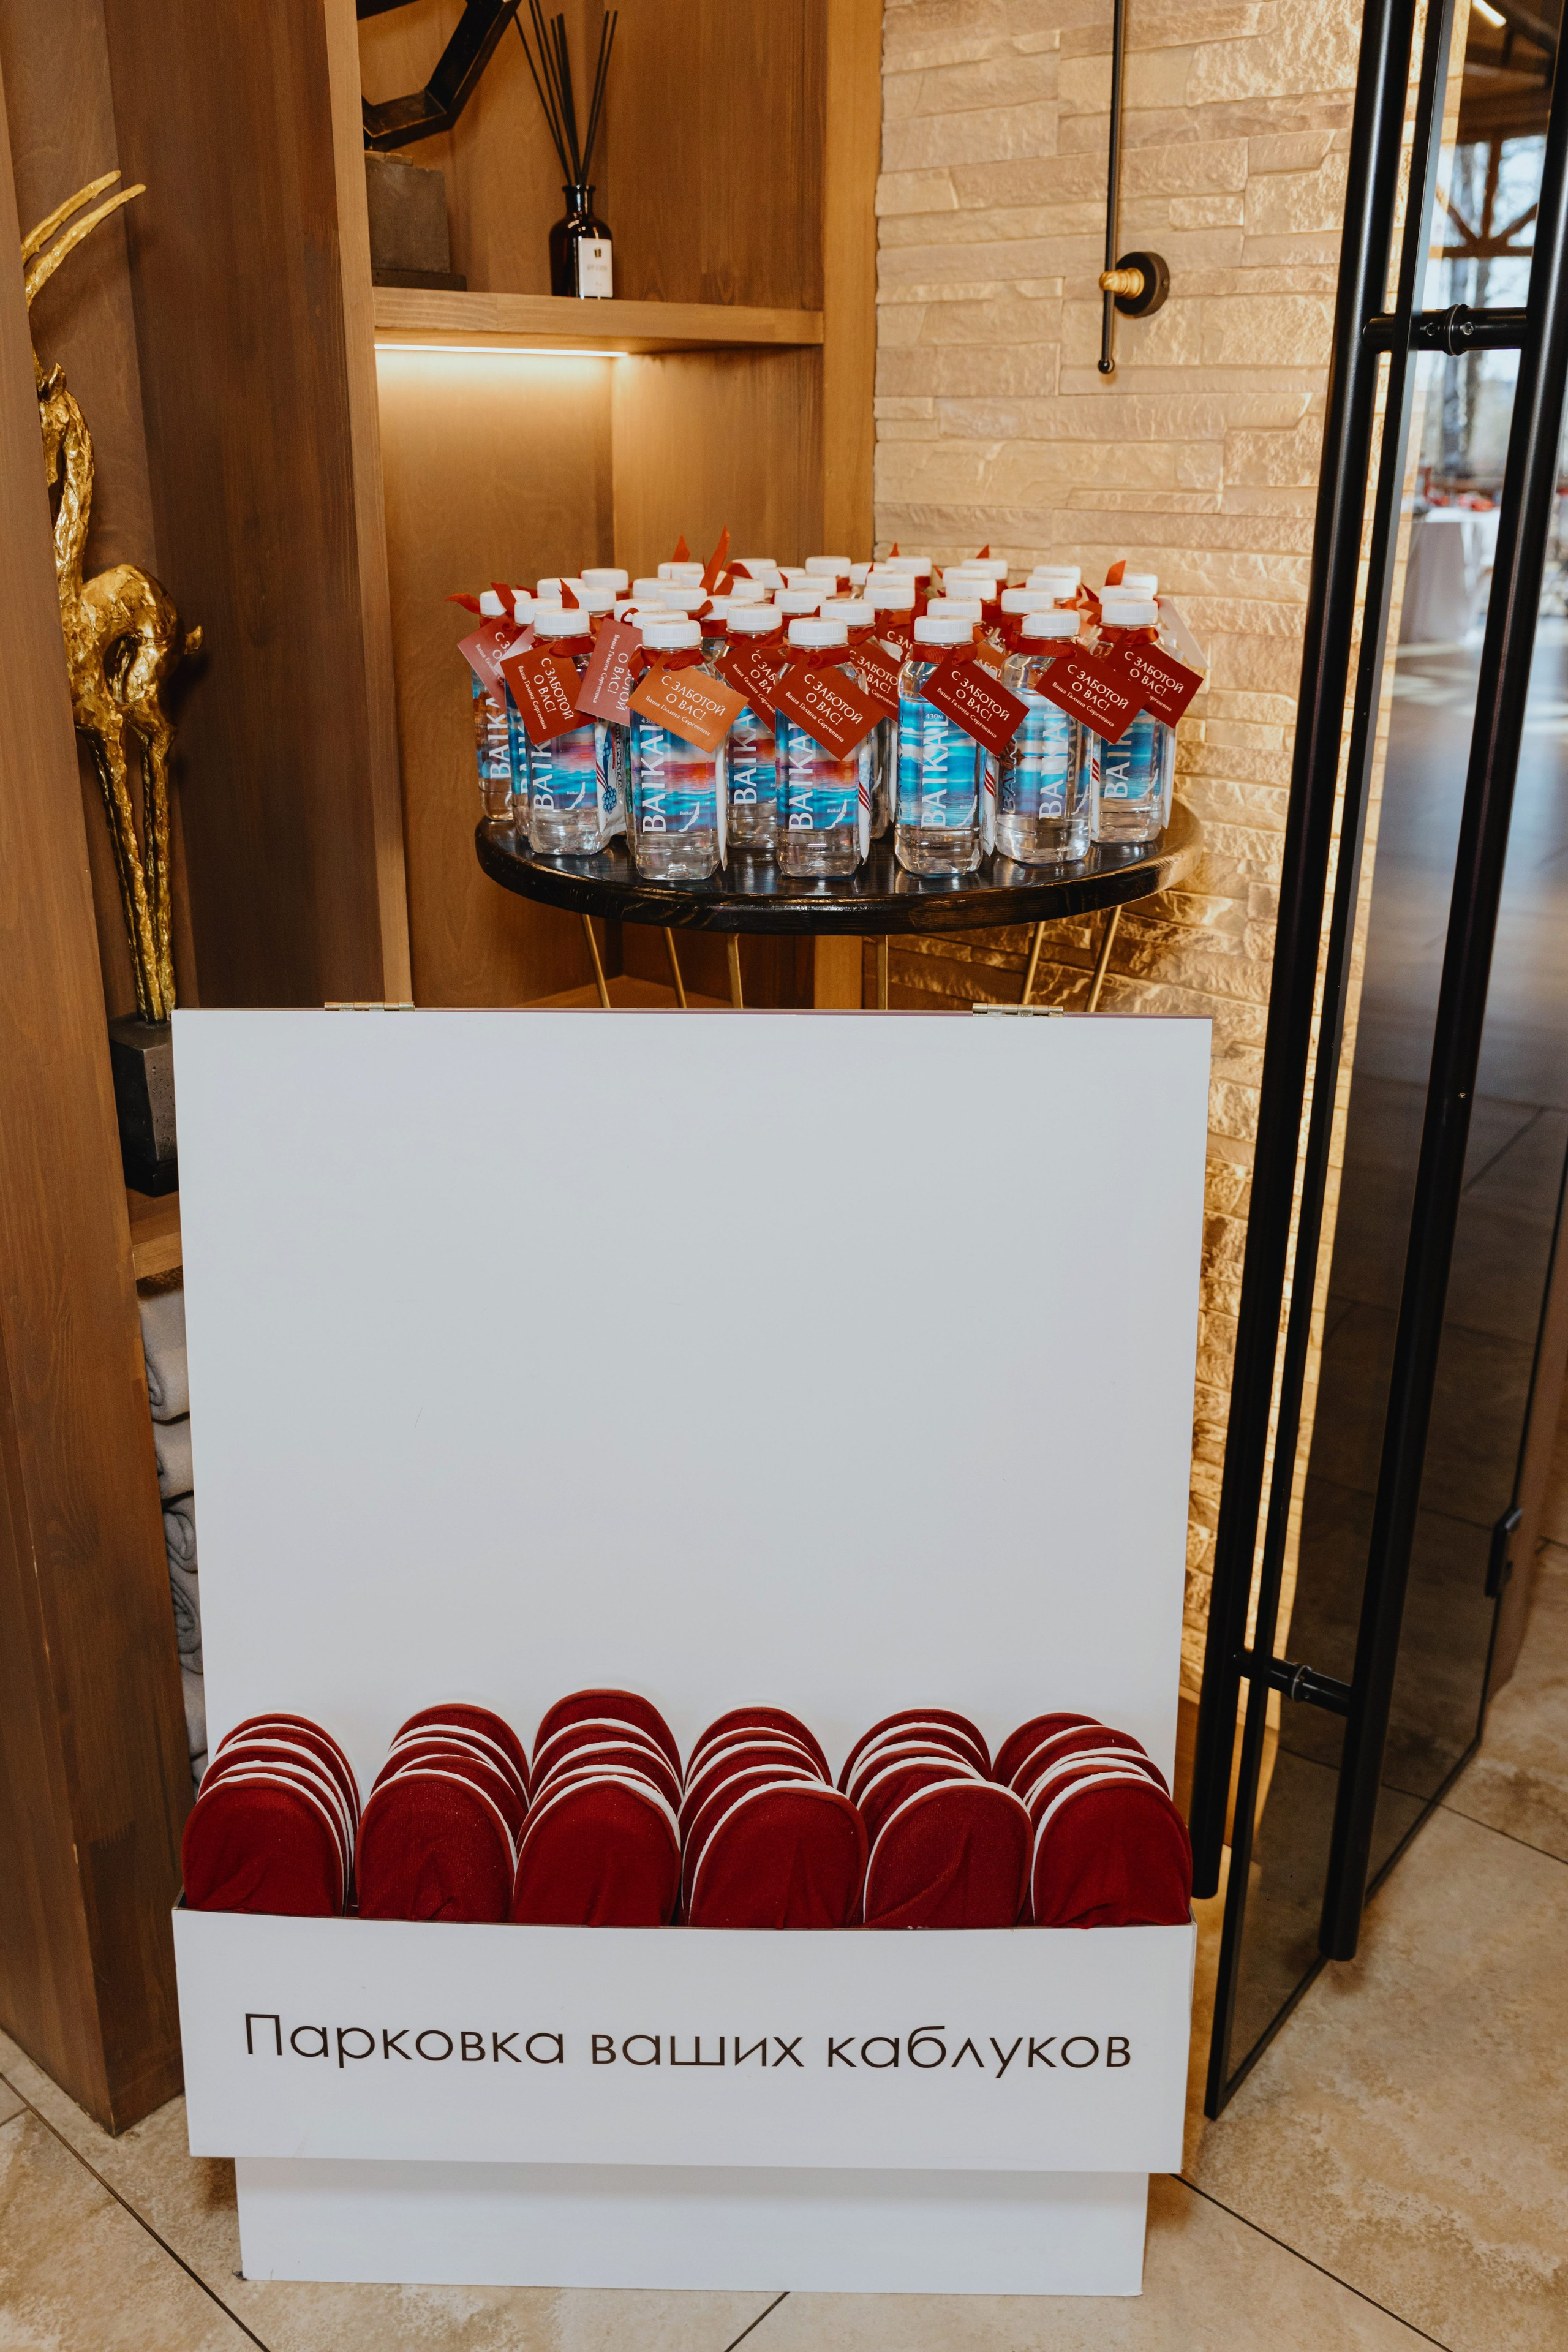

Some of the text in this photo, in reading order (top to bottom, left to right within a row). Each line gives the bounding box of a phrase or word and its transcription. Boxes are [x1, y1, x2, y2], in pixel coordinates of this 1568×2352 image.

[492, 649, 502, 659] О
[592, 634, 620, 703] Ваша Галина Сергеевна
[607, 652, 628, 695] О ВАС!
[751, 653, 761, 662] С
[858, 656, 898, 685] ЗАБОТО
[1125, 651, 1184, 693] С ЗАБОТОЙ
[518, 665, 547, 729] Ваша Галина Сергеевна
[533, 674, 557, 713] О ВАС!
[541, 658, 574, 720] С ЗАБОТОЙ
[662, 676, 726, 717] С ЗАБОТОЙ
[732, 663, 744, 677] Ваша
[743, 676, 758, 694] Галина
[750, 669, 760, 679] О
[758, 679, 772, 694] ВА
[866, 673, 891, 693] ВАС!
[871, 689, 898, 709] Сергеевна
[951, 671, 1010, 721] С ЗАБОТОЙ
[1067, 665, 1129, 709] С ЗАБОТОЙ
[1072, 682, 1110, 711] О ВАС!
[1129, 668, 1167, 696] О ВАС!
[645, 695, 710, 736] Ваша Галина Сергеевна
[666, 693, 706, 720] О ВАС!
[785, 691, 844, 742] Ваша Галина Сергеевна
[804, 674, 863, 725] С ЗАБОТОЙ
[806, 693, 843, 725] О ВАС!
[937, 687, 997, 738] Ваша Галина Сергеевна
[956, 689, 992, 722] О ВАС!
[1052, 682, 1115, 727] Ваша Галина Сергеевна
[531, 739, 554, 810] BAIK
[734, 714, 757, 805] BAIKA
[921, 718, 948, 829] BAIKAL
[245, 2013, 1130, 2078] Парковка ваших каблуков
